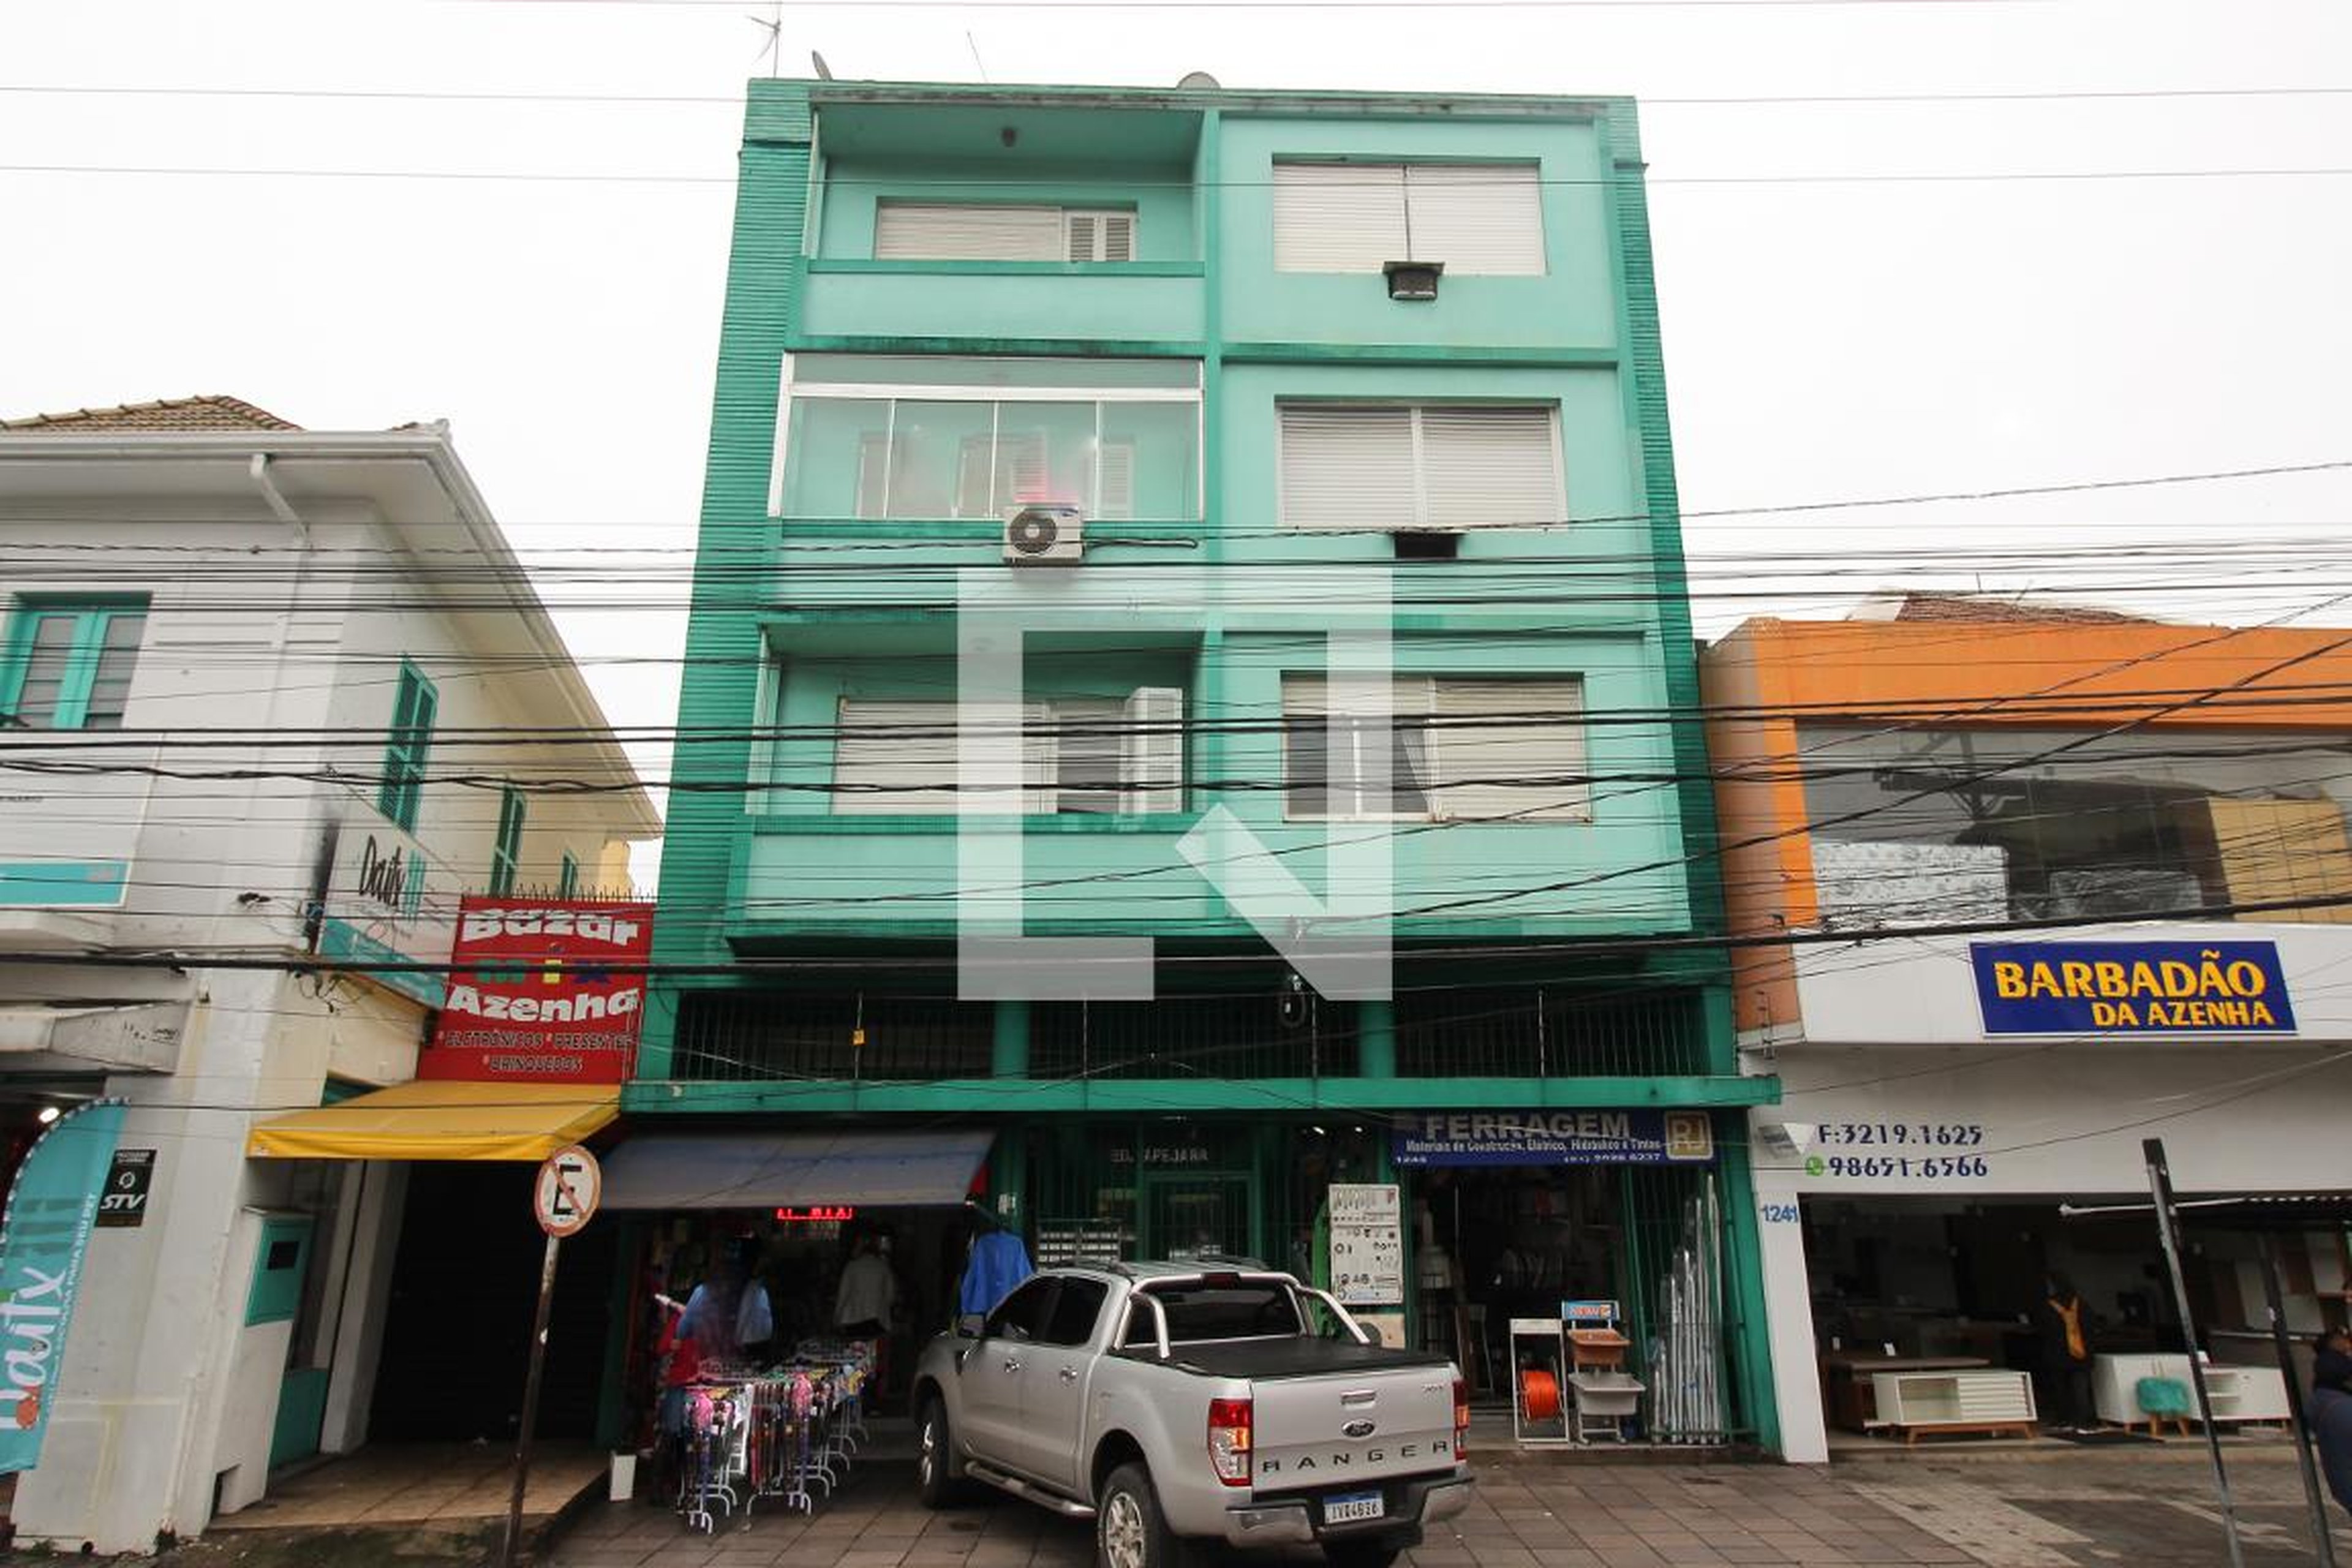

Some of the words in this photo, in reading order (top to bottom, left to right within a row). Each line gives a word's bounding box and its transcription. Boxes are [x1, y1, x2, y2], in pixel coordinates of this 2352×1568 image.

[461, 908, 638, 946] Bazar
[1994, 949, 2265, 998] BARBADÃO
[446, 985, 639, 1022] Azenha
[2091, 1002, 2139, 1026] DA
[2147, 1002, 2275, 1026] AZENHA
[1426, 1112, 1630, 1140] FERRAGEM
[1819, 1124, 1982, 1145] F:3219.1625
[1829, 1156, 1988, 1177] 98651.6566
[100, 1194, 146, 1210] STV
[1762, 1204, 1798, 1223] 1241
[1262, 1441, 1448, 1472] RANGER
